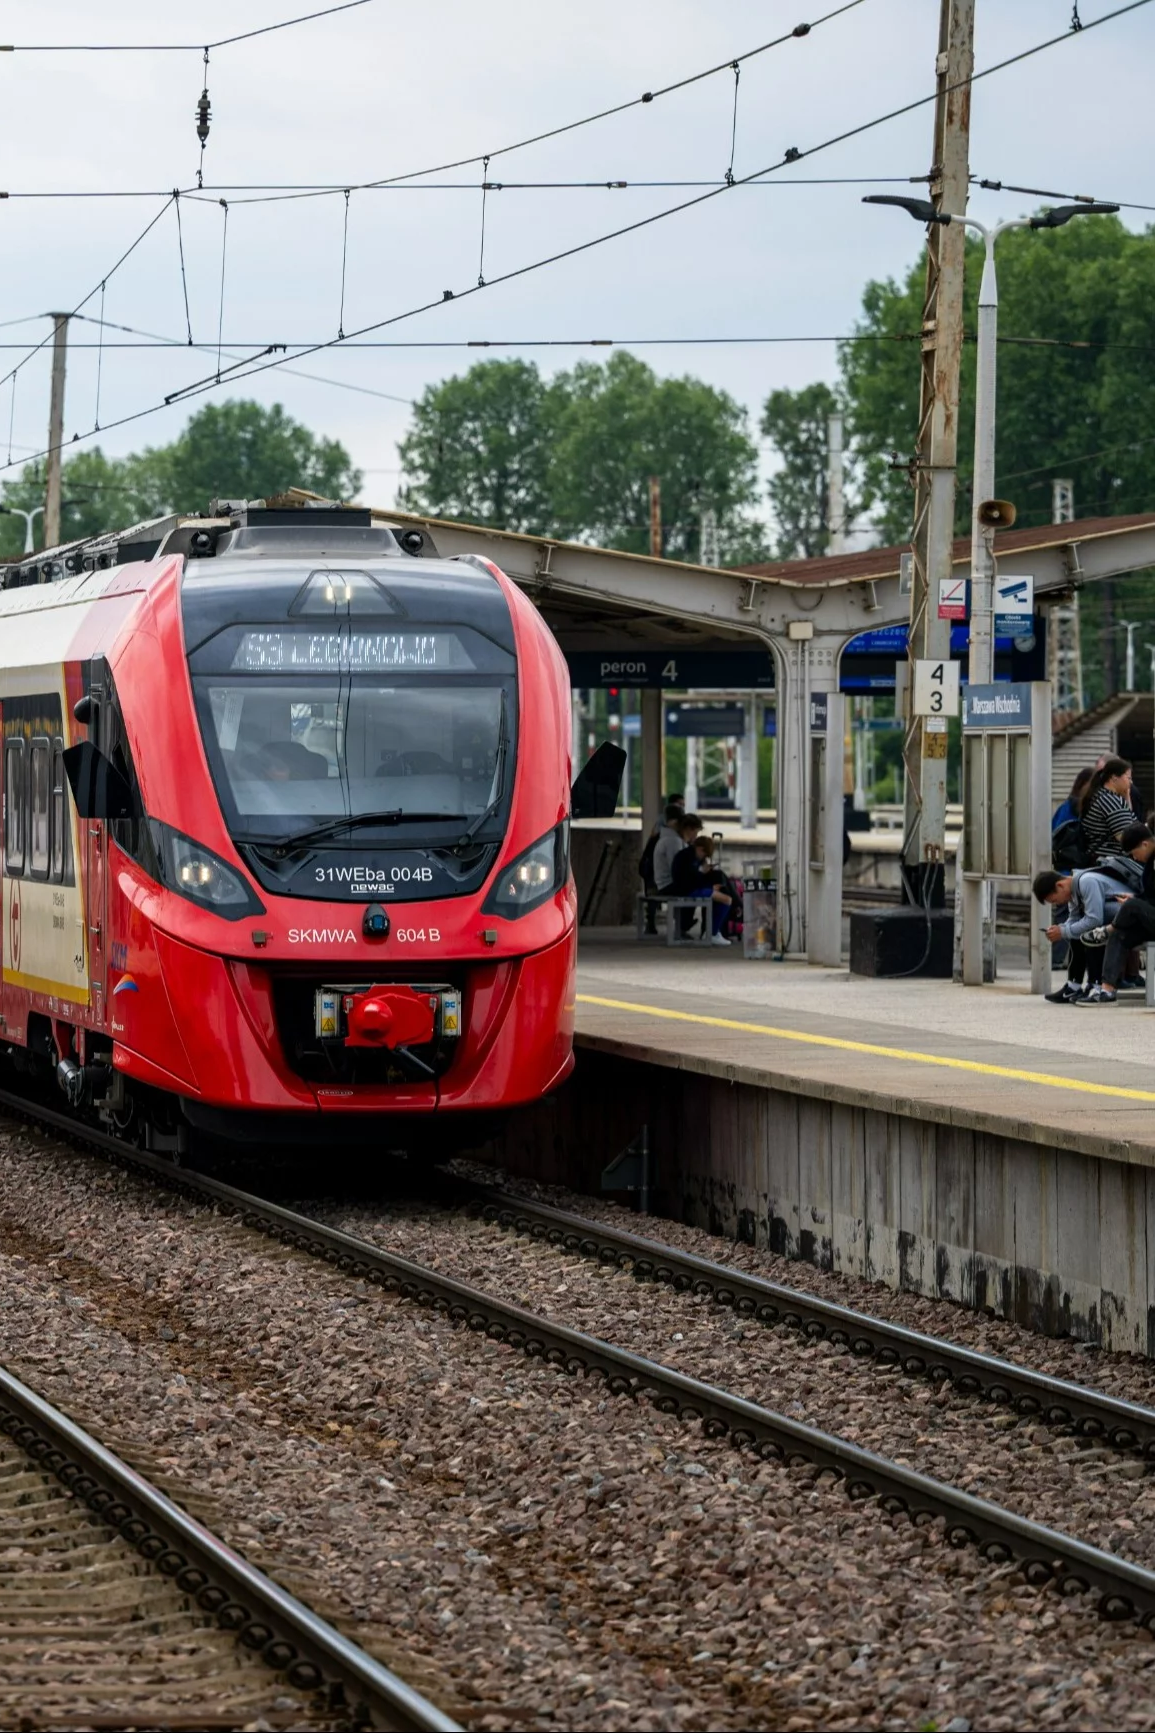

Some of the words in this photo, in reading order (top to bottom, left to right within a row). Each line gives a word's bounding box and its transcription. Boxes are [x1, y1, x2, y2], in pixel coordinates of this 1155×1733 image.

[600, 661, 646, 676] peron
[661, 660, 678, 682] 4
[930, 663, 944, 685] 4
[930, 691, 943, 713] 3
[315, 867, 386, 882] 31WEba
[390, 867, 433, 882] 004B
[350, 883, 395, 892] newag
[288, 929, 357, 943] SKMWA
